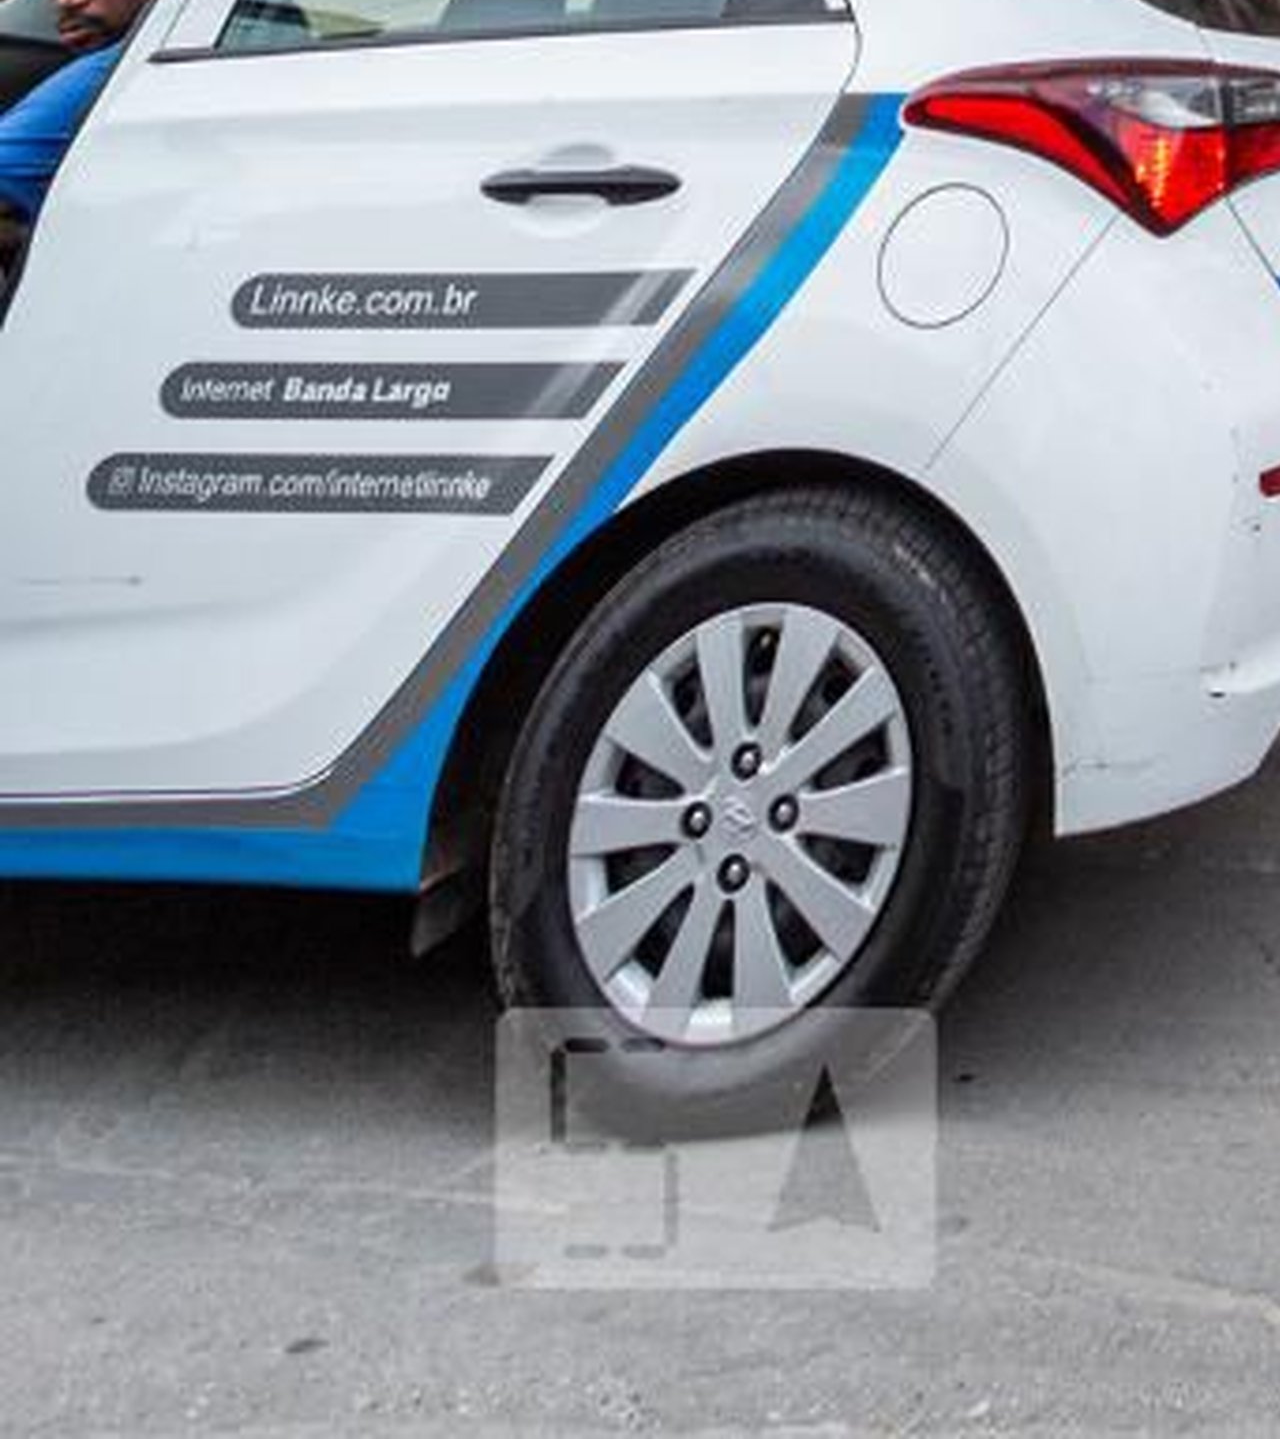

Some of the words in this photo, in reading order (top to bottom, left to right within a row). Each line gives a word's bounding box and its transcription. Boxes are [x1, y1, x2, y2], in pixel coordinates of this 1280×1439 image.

[250, 283, 478, 315] Linnke.com.br
[179, 377, 275, 402] Internet
[282, 376, 367, 402] Banda
[371, 377, 451, 409] Larga
